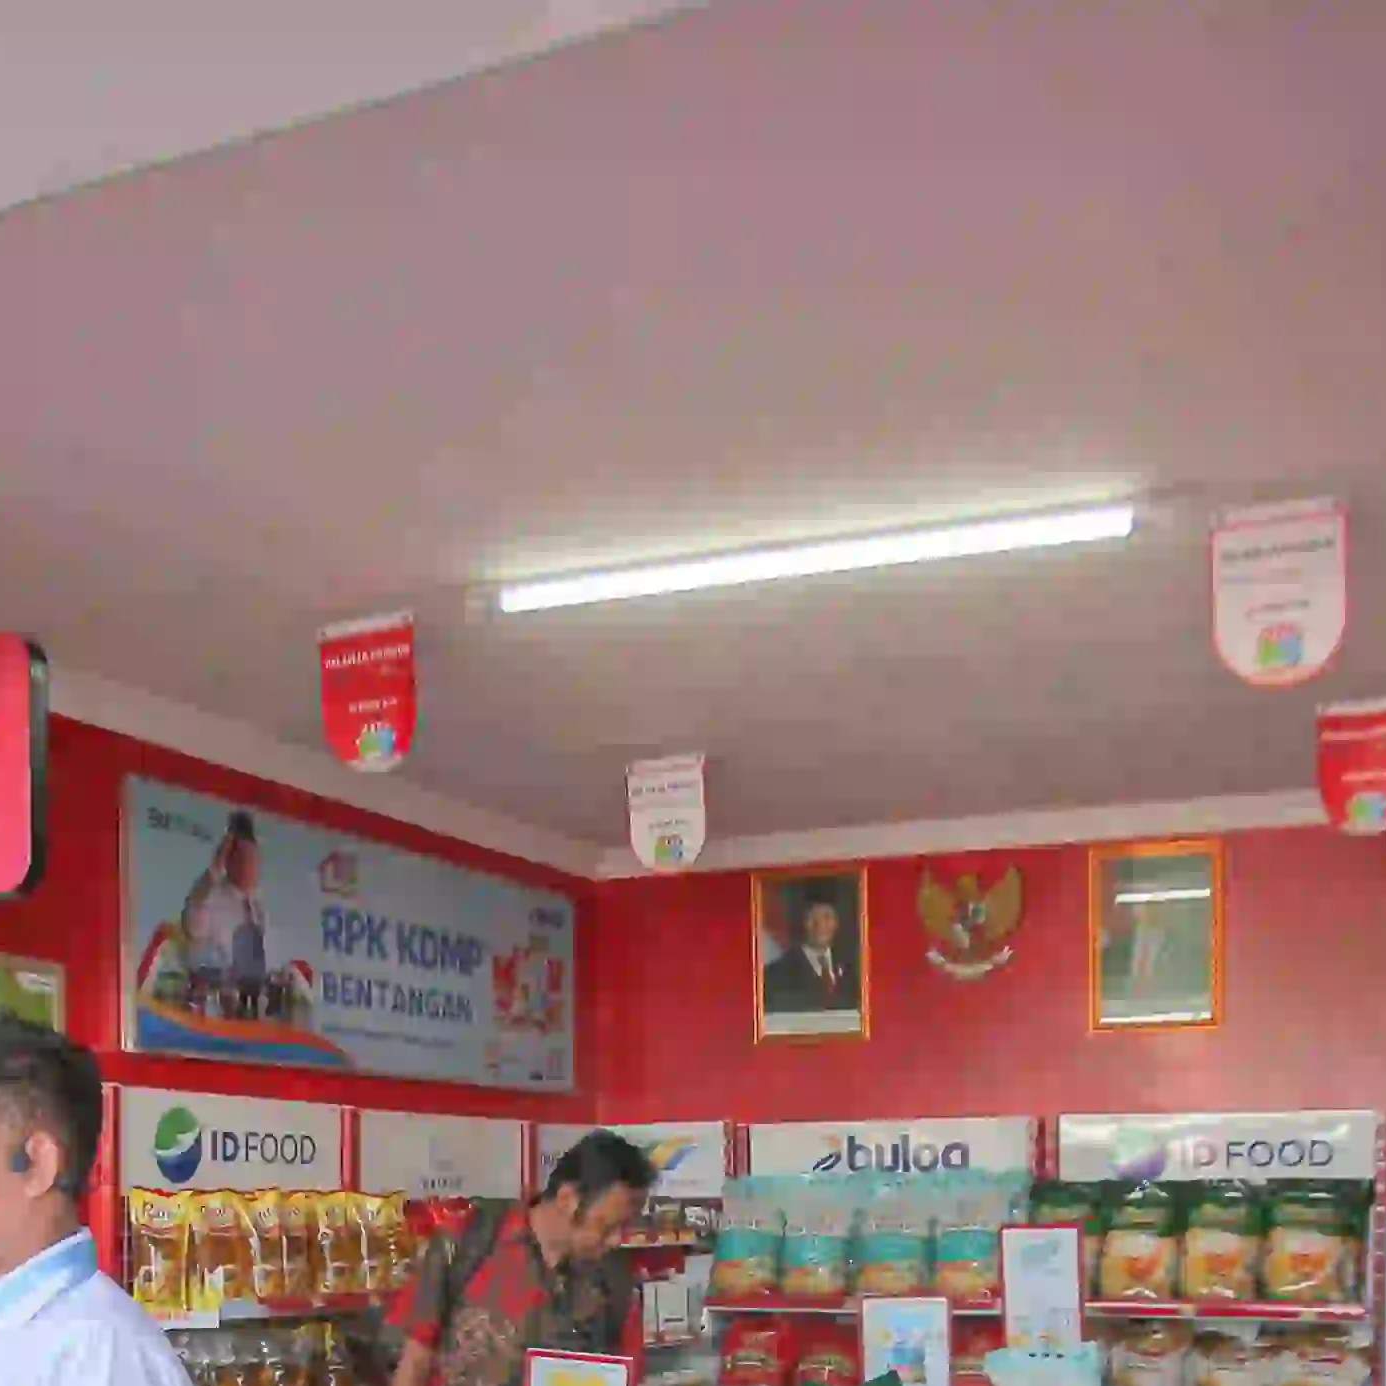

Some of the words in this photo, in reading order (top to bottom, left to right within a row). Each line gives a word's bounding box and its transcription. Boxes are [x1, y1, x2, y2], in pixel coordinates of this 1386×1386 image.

[321, 904, 389, 961] RPK
[321, 970, 474, 1024] BENTANGAN
[210, 1129, 240, 1164] ID
[245, 1132, 317, 1166] FOOD
[1226, 1139, 1335, 1169] FOOD
